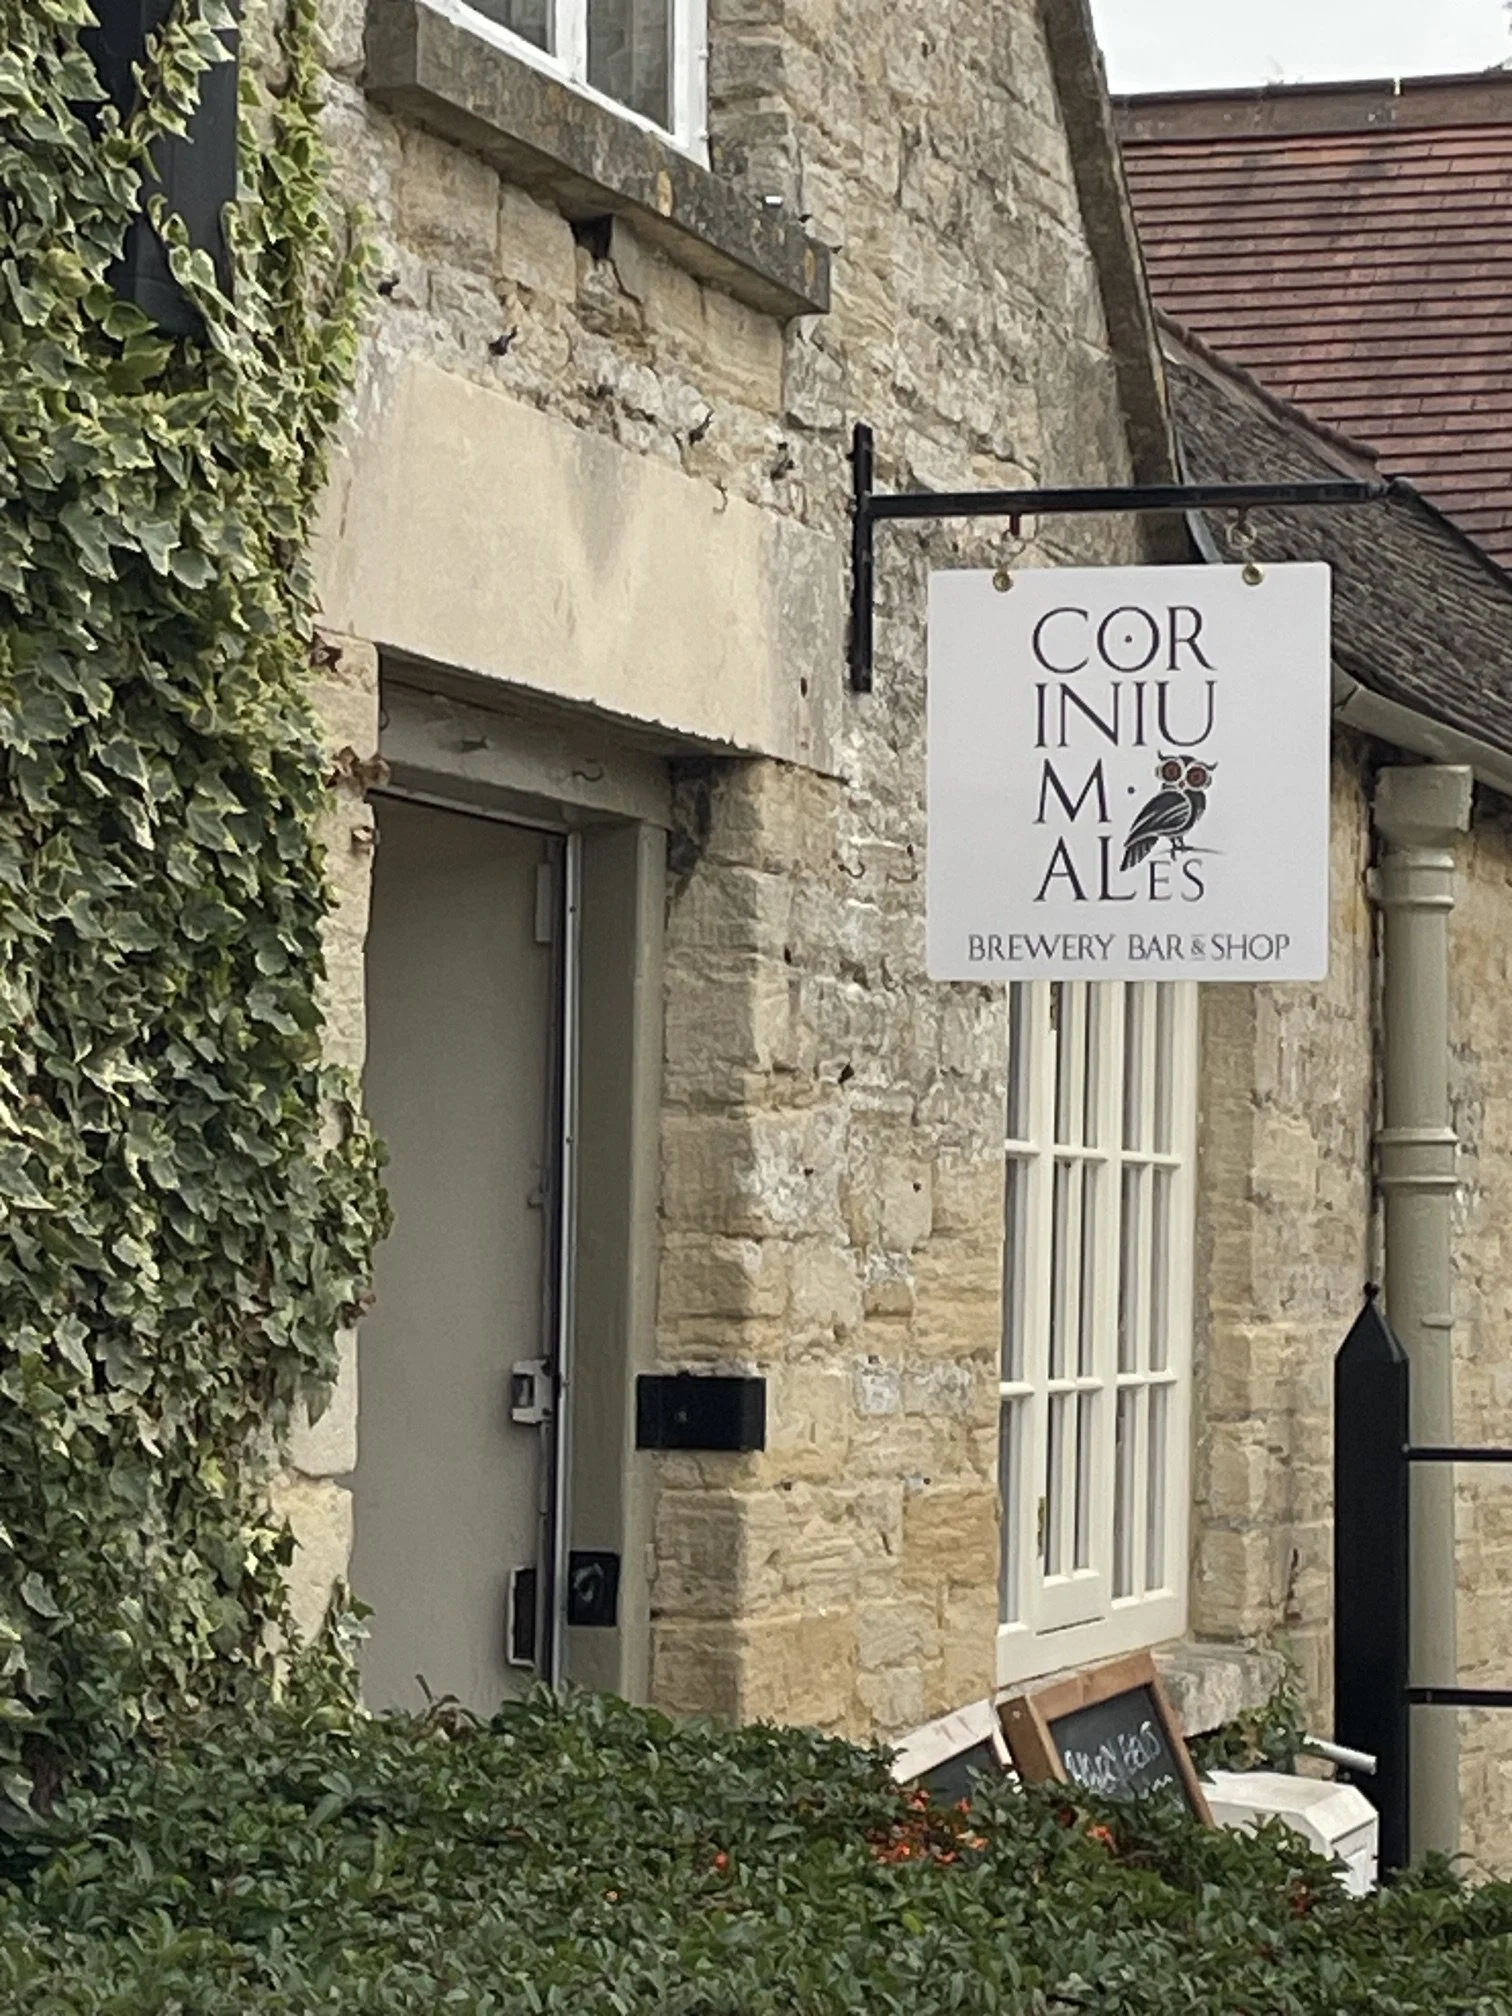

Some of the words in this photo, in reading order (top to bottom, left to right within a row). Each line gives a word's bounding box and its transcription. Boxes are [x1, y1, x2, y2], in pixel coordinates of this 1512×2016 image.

[1032, 606, 1216, 673] COR
[1035, 681, 1218, 747] INIU
[1033, 836, 1205, 902] ALES
[968, 934, 1115, 961] BREWERY
[1128, 934, 1184, 961] BAR
[1211, 934, 1290, 961] SHOP
